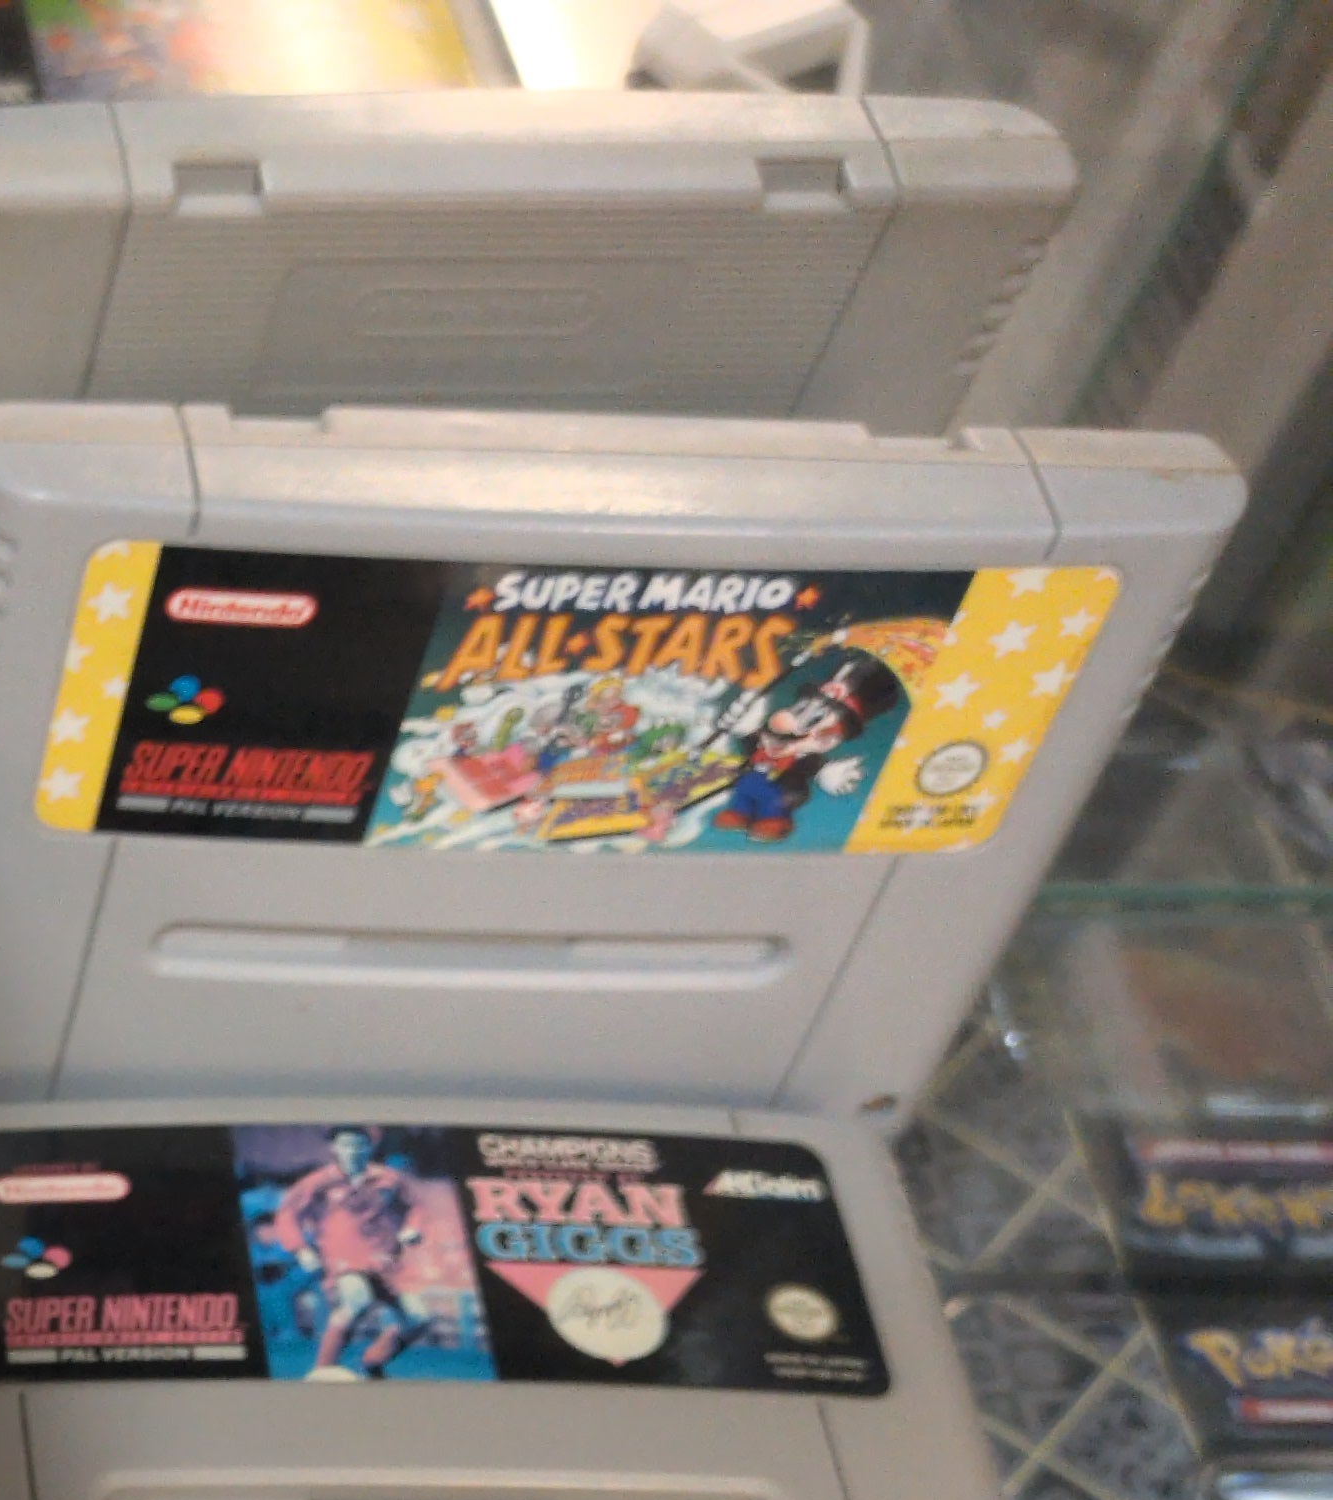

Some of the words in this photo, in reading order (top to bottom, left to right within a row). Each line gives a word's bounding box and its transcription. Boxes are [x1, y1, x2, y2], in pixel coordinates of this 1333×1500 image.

[493, 570, 639, 613] SUPER
[637, 573, 795, 614] MARIO
[123, 739, 229, 784] SUPER
[220, 744, 376, 792] NINTENDO
[466, 1176, 686, 1228] RYAN
[475, 1221, 706, 1267] GIGGS
[5, 1295, 97, 1332] SUPER
[101, 1292, 239, 1331] NINTENDO
